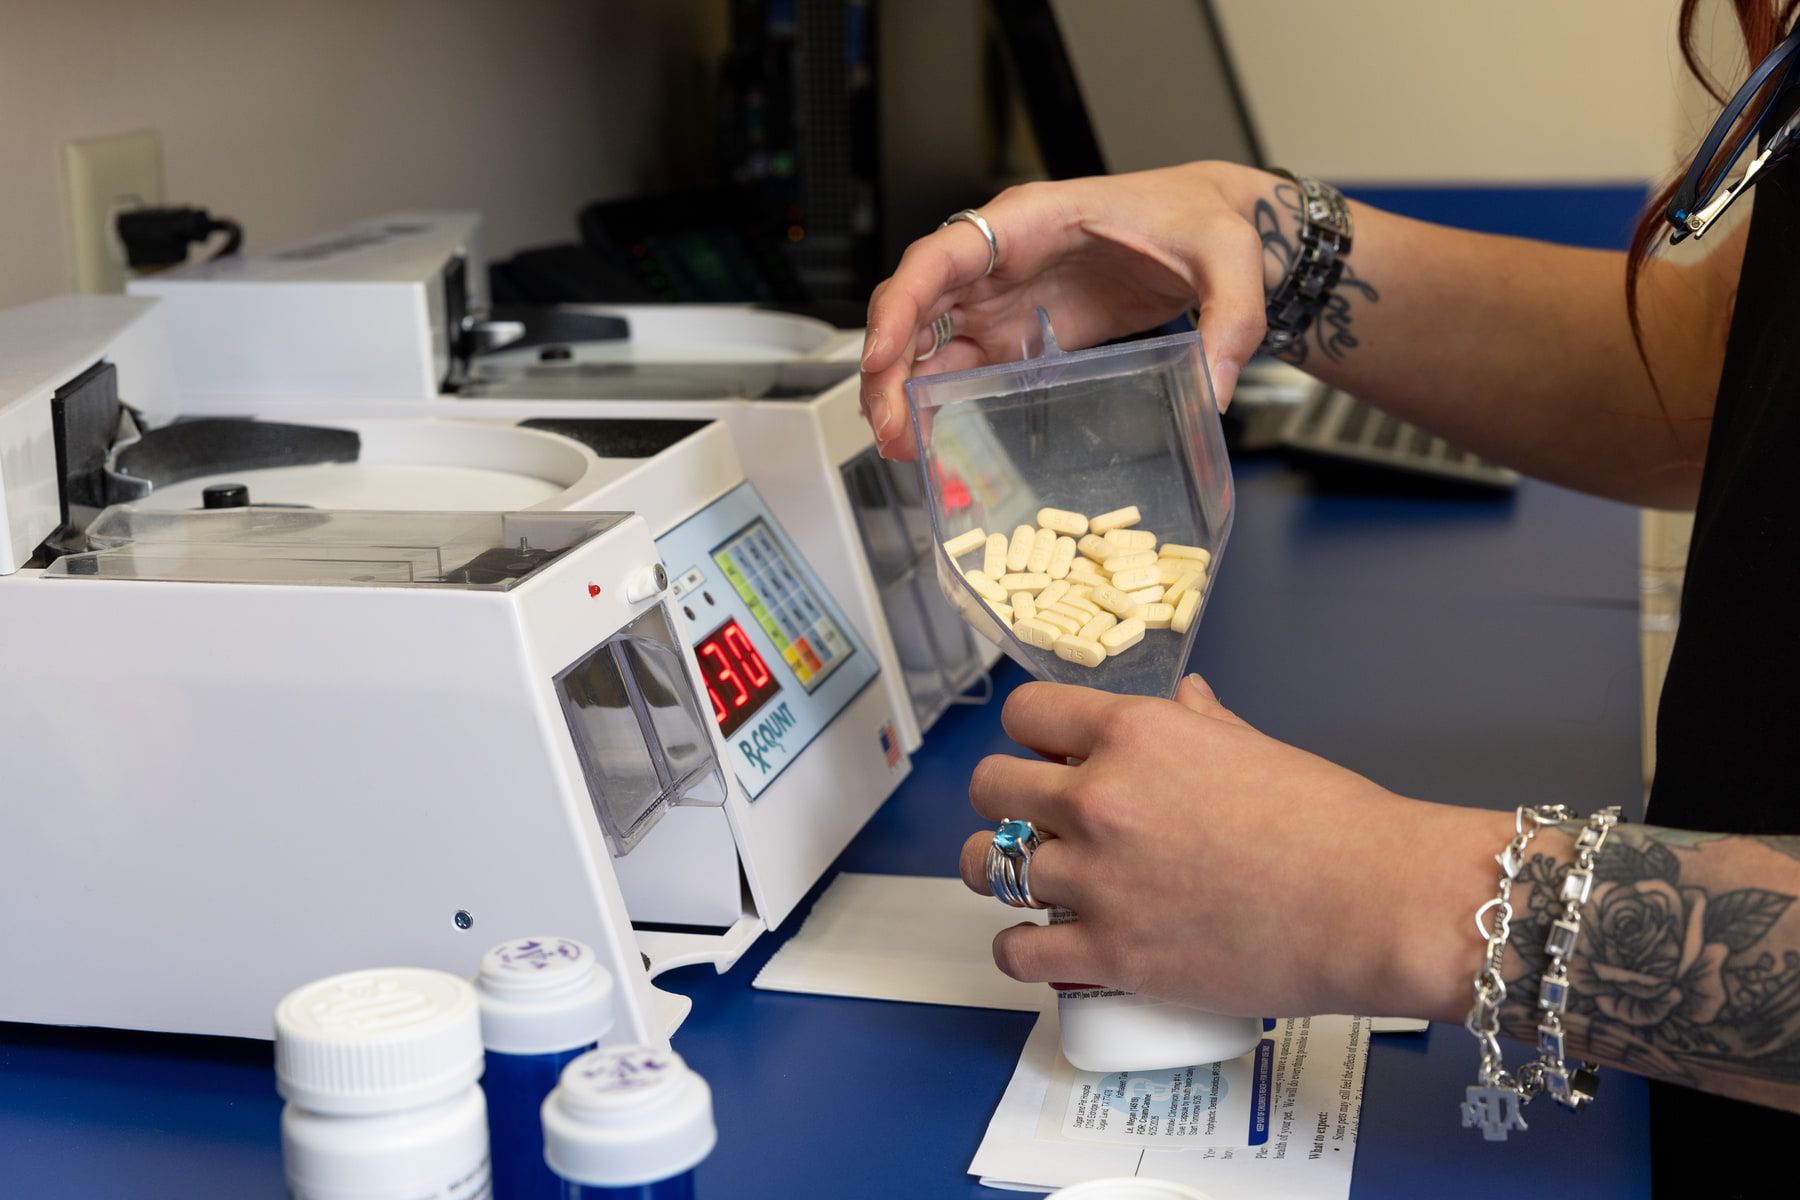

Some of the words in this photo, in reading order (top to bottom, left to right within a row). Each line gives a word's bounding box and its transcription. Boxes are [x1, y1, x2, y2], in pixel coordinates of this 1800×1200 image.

[1280, 1037, 1292, 1055] question
[1277, 1060, 1286, 1071] have
[1291, 1054, 1306, 1079] everything
[1343, 1053, 1356, 1069] effects
[1341, 1070, 1353, 1078] the
[1184, 1077, 1193, 1087] twice
[1340, 1079, 1352, 1089] feel
[1080, 1084, 1091, 1099] Hospital
[1259, 1083, 1267, 1093] REACH
[1284, 1087, 1297, 1097] will
[1091, 1093, 1100, 1102] Road
[1182, 1088, 1191, 1100] mouth
[1339, 1089, 1351, 1100] still
[1208, 1097, 1218, 1109] Dental
[1282, 1098, 1295, 1107] We
[1340, 1101, 1352, 1112] may
[1076, 1106, 1086, 1115] Land
[1180, 1107, 1190, 1122] capsule
[1190, 1105, 1200, 1124] Tomorrow
[1284, 1111, 1295, 1120] pet.
[1073, 1116, 1084, 1127] Sugar
[1126, 1112, 1137, 1125] Megan
[1205, 1110, 1217, 1135] Prophylactic
[1337, 1113, 1349, 1124] pets
[1096, 1119, 1108, 1130] Sugar
[1189, 1125, 1198, 1135] Start
[1256, 1123, 1264, 1131] KEEP
[1281, 1121, 1292, 1134] your
[1177, 1126, 1186, 1135] Give
[1309, 1142, 1323, 1159] What
[1317, 1111, 1329, 1133] expect:
[1332, 1125, 1345, 1140] Some
[1274, 1141, 1286, 1159] health
